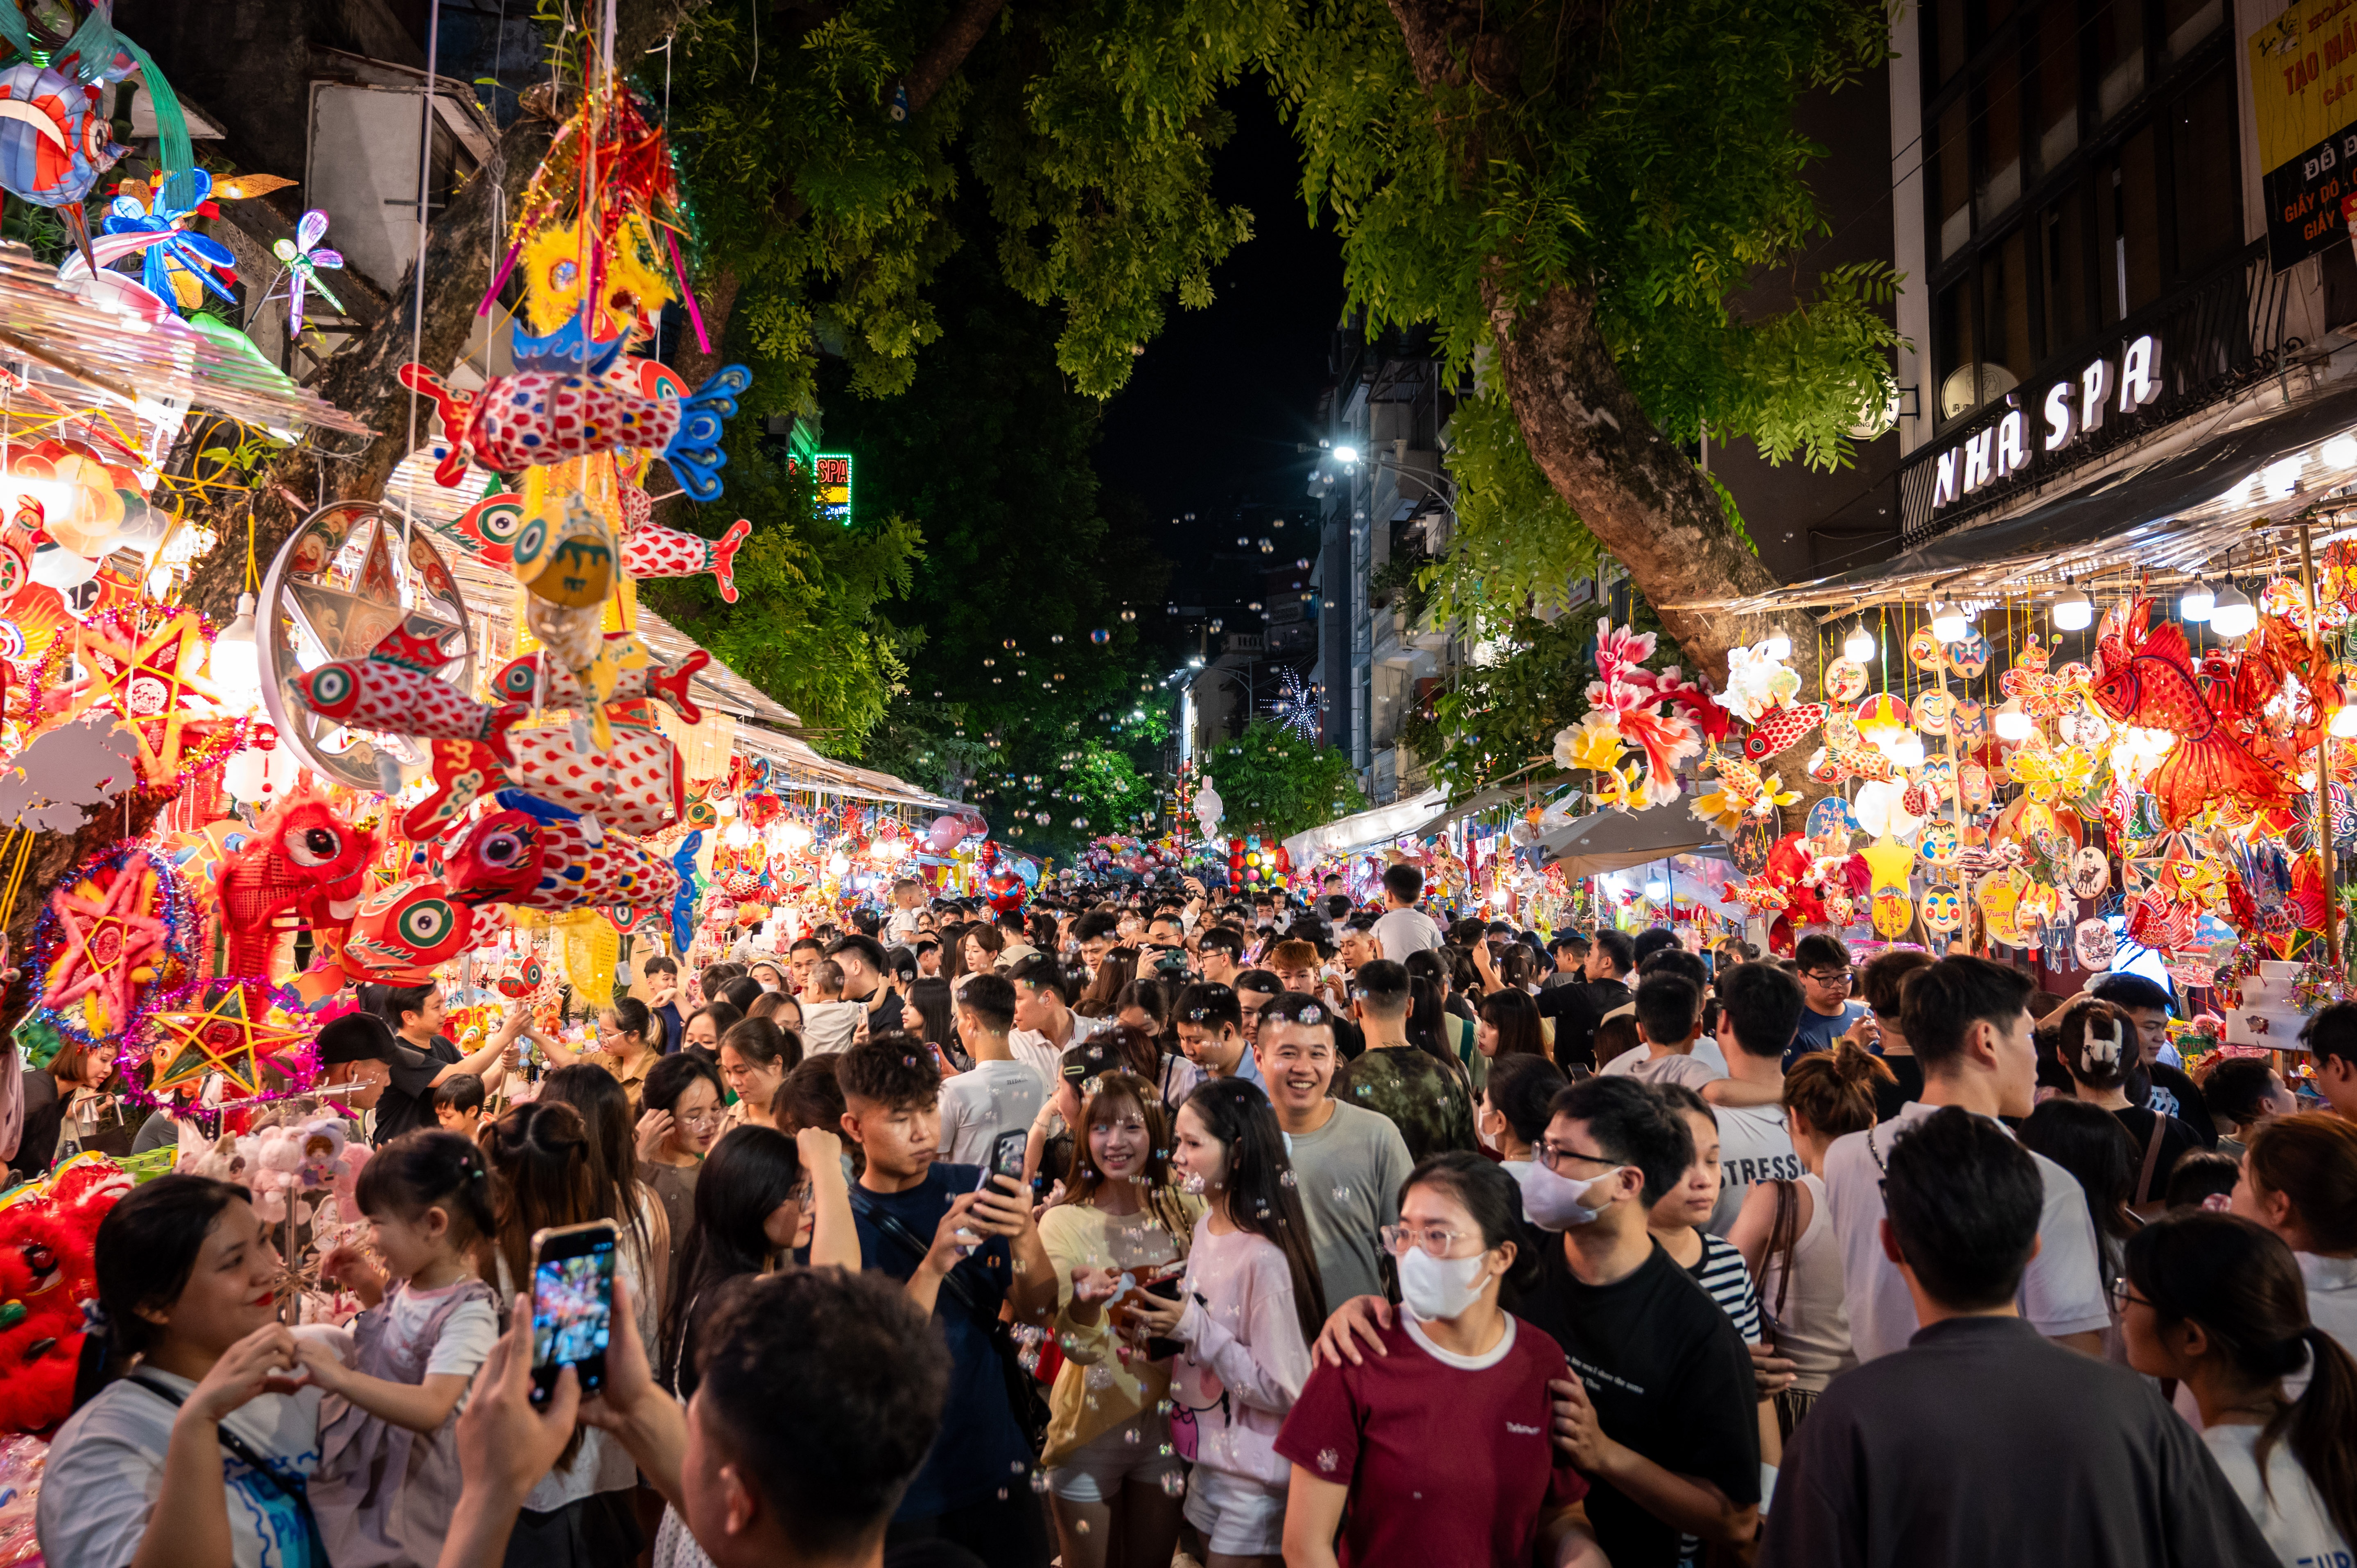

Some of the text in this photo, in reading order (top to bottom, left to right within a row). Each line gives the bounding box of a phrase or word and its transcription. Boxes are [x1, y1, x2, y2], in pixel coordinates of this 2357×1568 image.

[1933, 335, 2162, 508] NHÀ SPA
[817, 459, 849, 482] SPA
[1986, 909, 2011, 922] Trung
[2001, 926, 2016, 935] Thu
